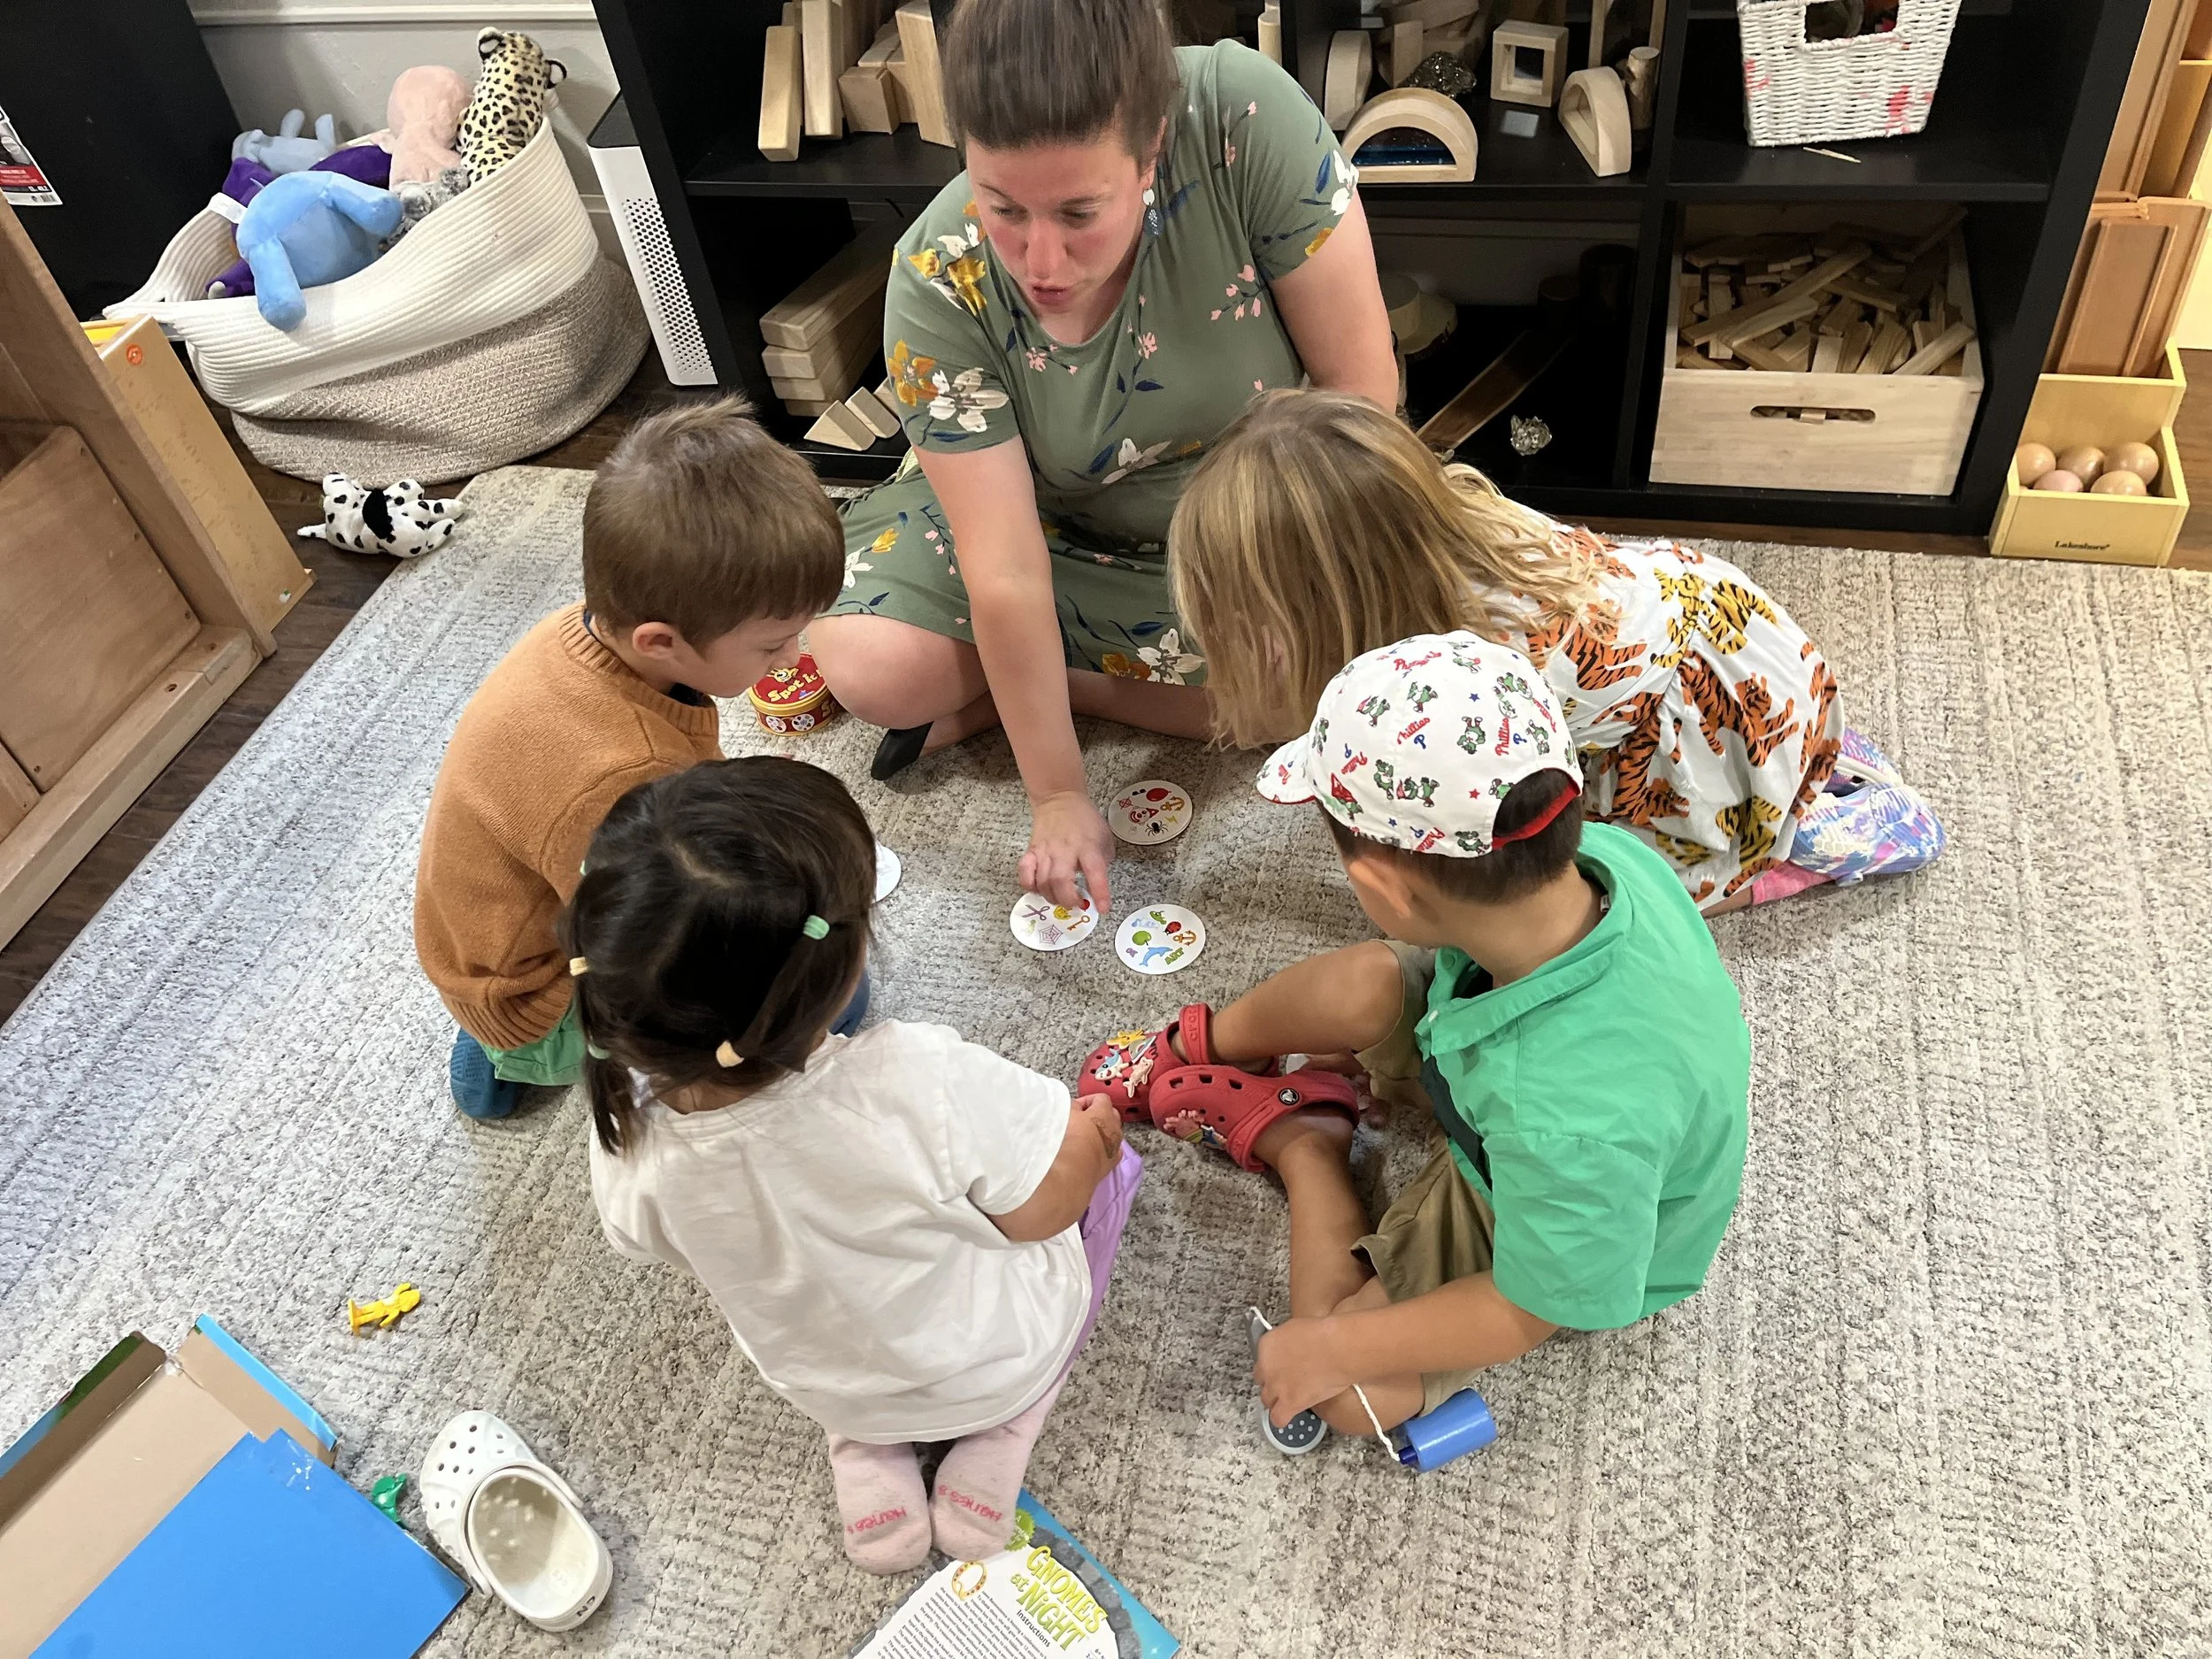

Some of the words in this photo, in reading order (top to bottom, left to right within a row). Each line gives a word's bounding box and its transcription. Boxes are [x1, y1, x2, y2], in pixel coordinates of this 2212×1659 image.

[2055, 541, 2107, 550] Lakeshore
[767, 680, 804, 703] Spot
[1495, 718, 1509, 757] Phillies
[1010, 1573, 1029, 1593] at
[1026, 1545, 1109, 1634] GNOMES
[1016, 1609, 1051, 1647] Instructions
